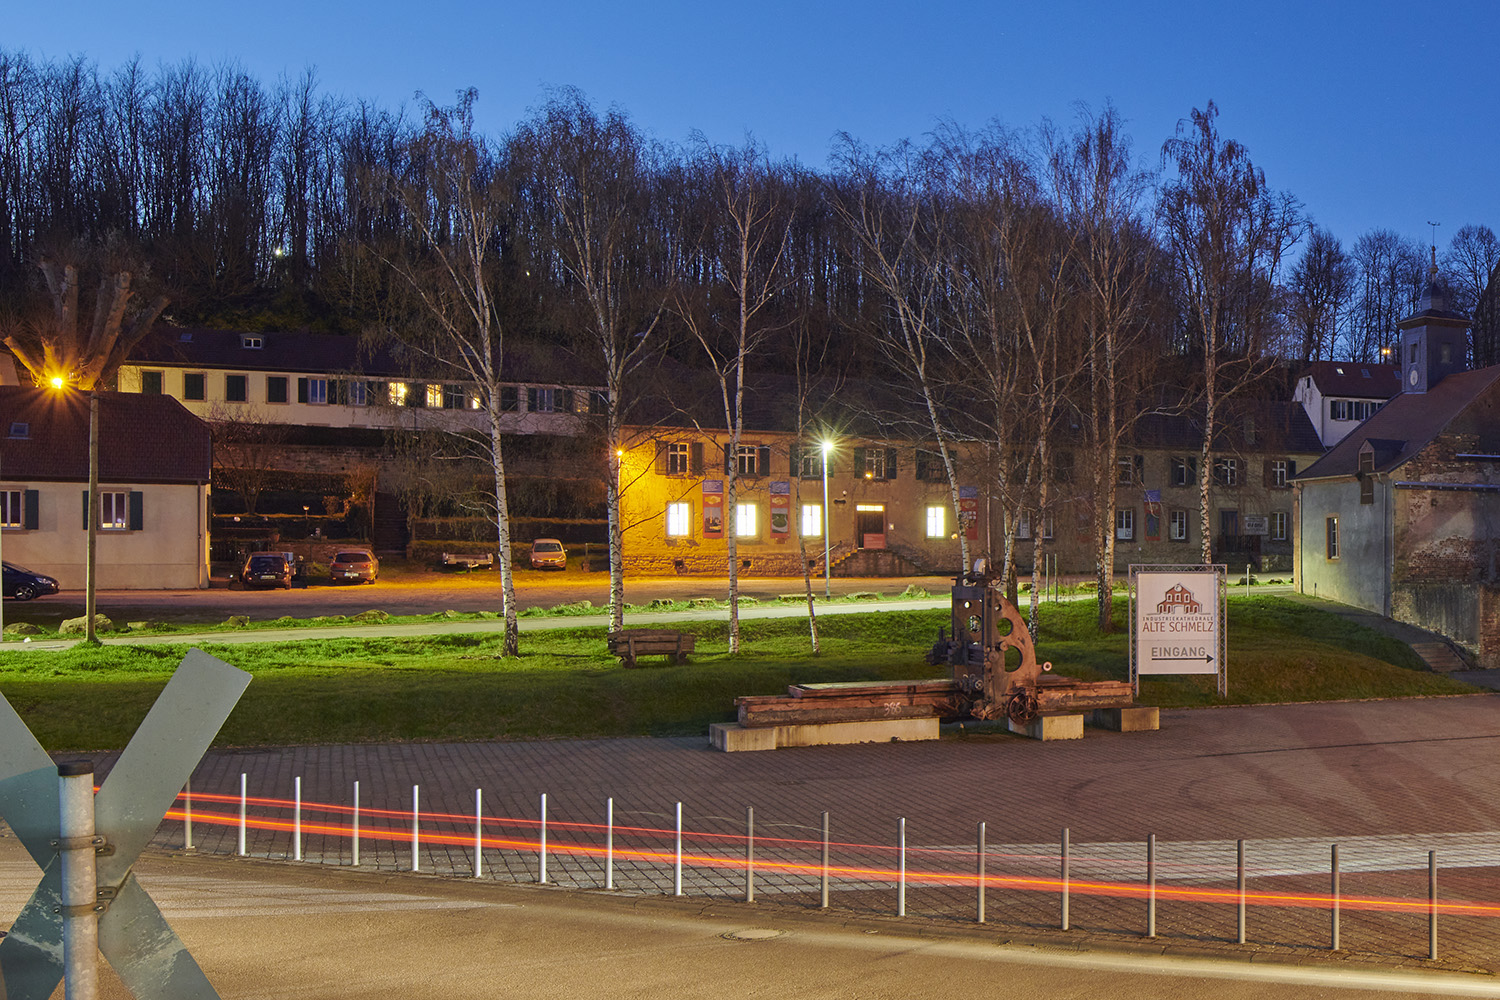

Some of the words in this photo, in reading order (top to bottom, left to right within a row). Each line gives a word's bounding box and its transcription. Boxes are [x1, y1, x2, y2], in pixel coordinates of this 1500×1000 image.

[1142, 622, 1166, 632] ALTE
[1169, 622, 1214, 632] SCHMELZ
[1151, 647, 1206, 657] EINGANG
